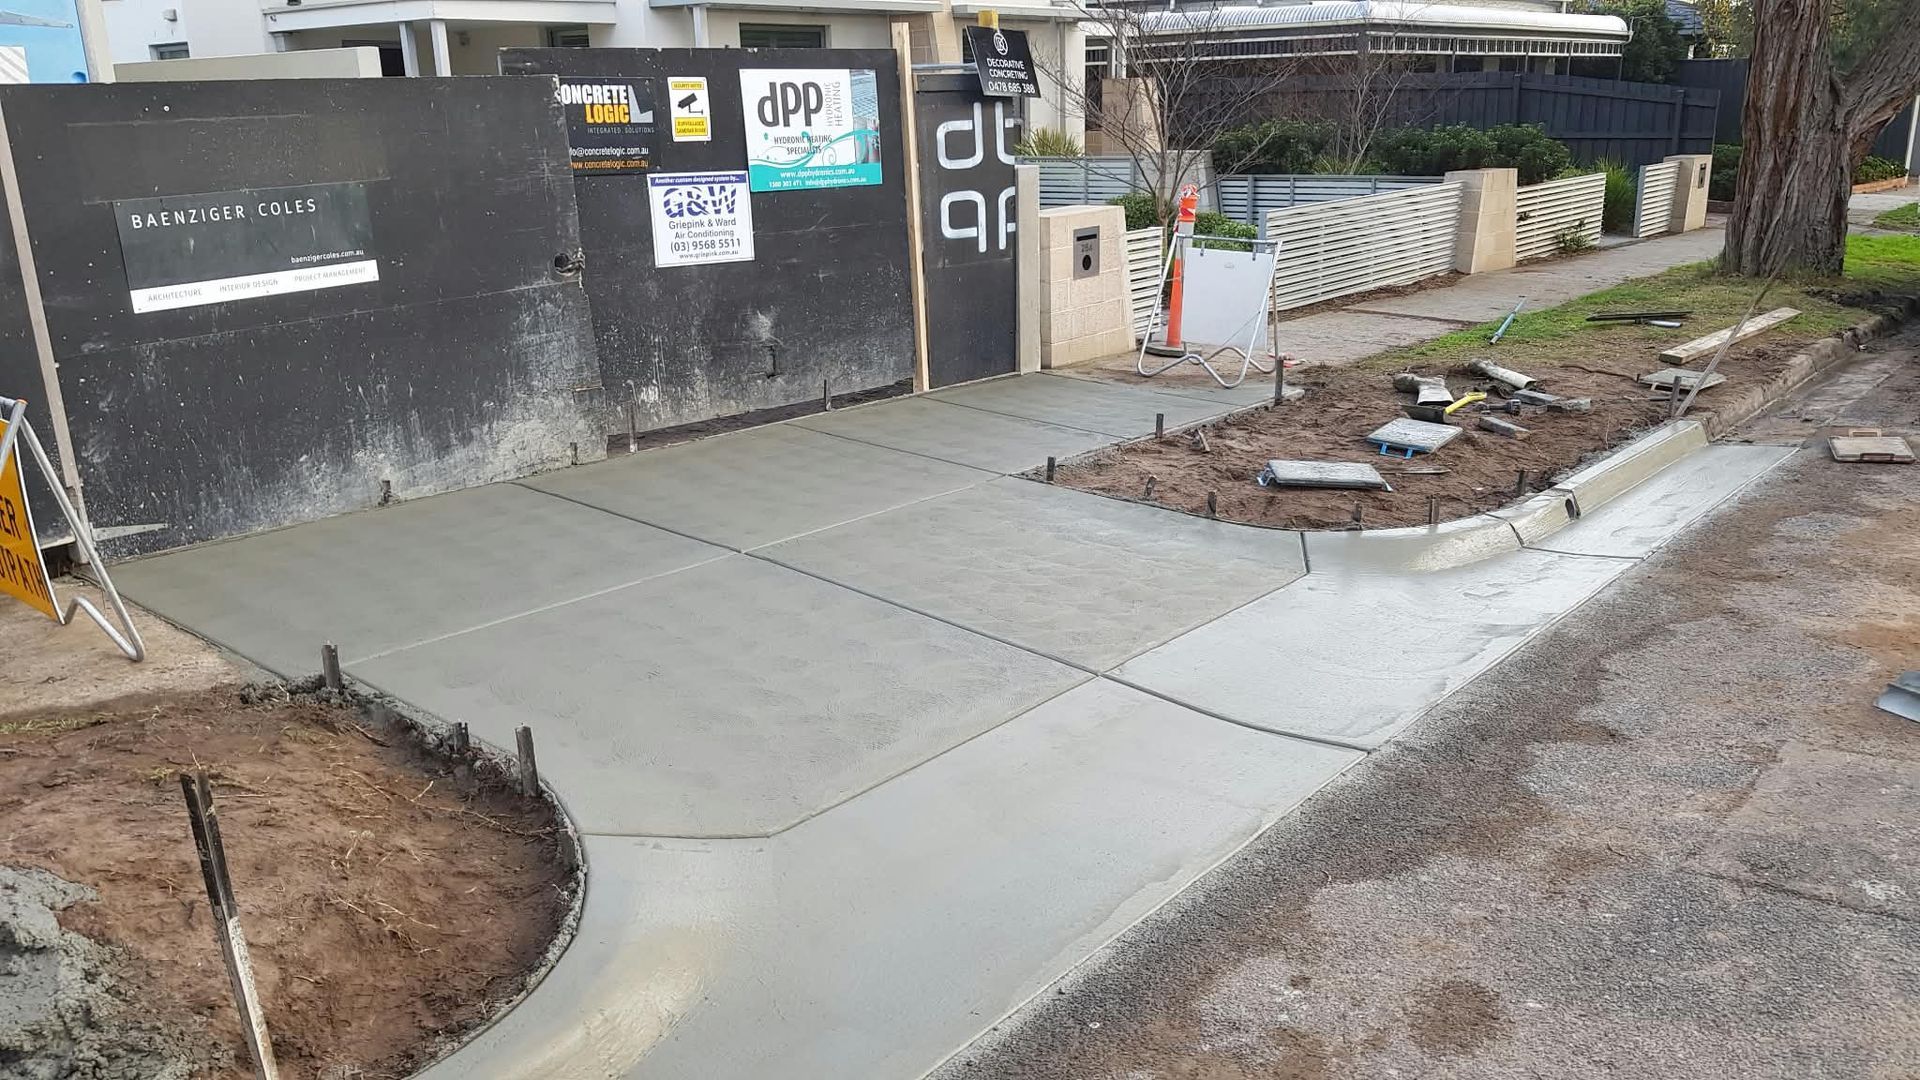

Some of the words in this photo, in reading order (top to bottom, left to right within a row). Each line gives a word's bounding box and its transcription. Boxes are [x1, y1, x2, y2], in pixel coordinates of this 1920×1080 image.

[987, 58, 1025, 69] DECORATIVE
[989, 69, 1028, 79] CONCRETING
[989, 81, 1007, 91] 0478
[1008, 82, 1021, 93] 685
[1022, 83, 1035, 94] 388
[824, 83, 833, 127] HYDRONIC
[833, 81, 843, 127] HEATING
[585, 104, 630, 123] LOGIC
[774, 135, 805, 144] HYDRONIC
[787, 146, 822, 155] SPECIALISTS
[663, 185, 737, 218] G&W
[131, 205, 246, 229] BAENZIGER
[258, 198, 317, 217] COLES
[669, 219, 705, 230] Griepink
[707, 219, 713, 227] &
[715, 217, 736, 227] Ward
[687, 229, 734, 239] Conditioning
[670, 241, 690, 253] (03)
[692, 239, 716, 250] 9568
[718, 238, 741, 249] 5511
[290, 249, 365, 264] baenzigercoles.com.au
[679, 249, 739, 259] www.griepink.com.au
[148, 288, 202, 302] ARCHITECTURE
[219, 282, 250, 293] INTERIOR
[252, 278, 279, 289] DESIGN
[294, 272, 321, 283] PROJECT
[322, 266, 366, 280] MANAGEMENT
[0, 494, 22, 540] ER
